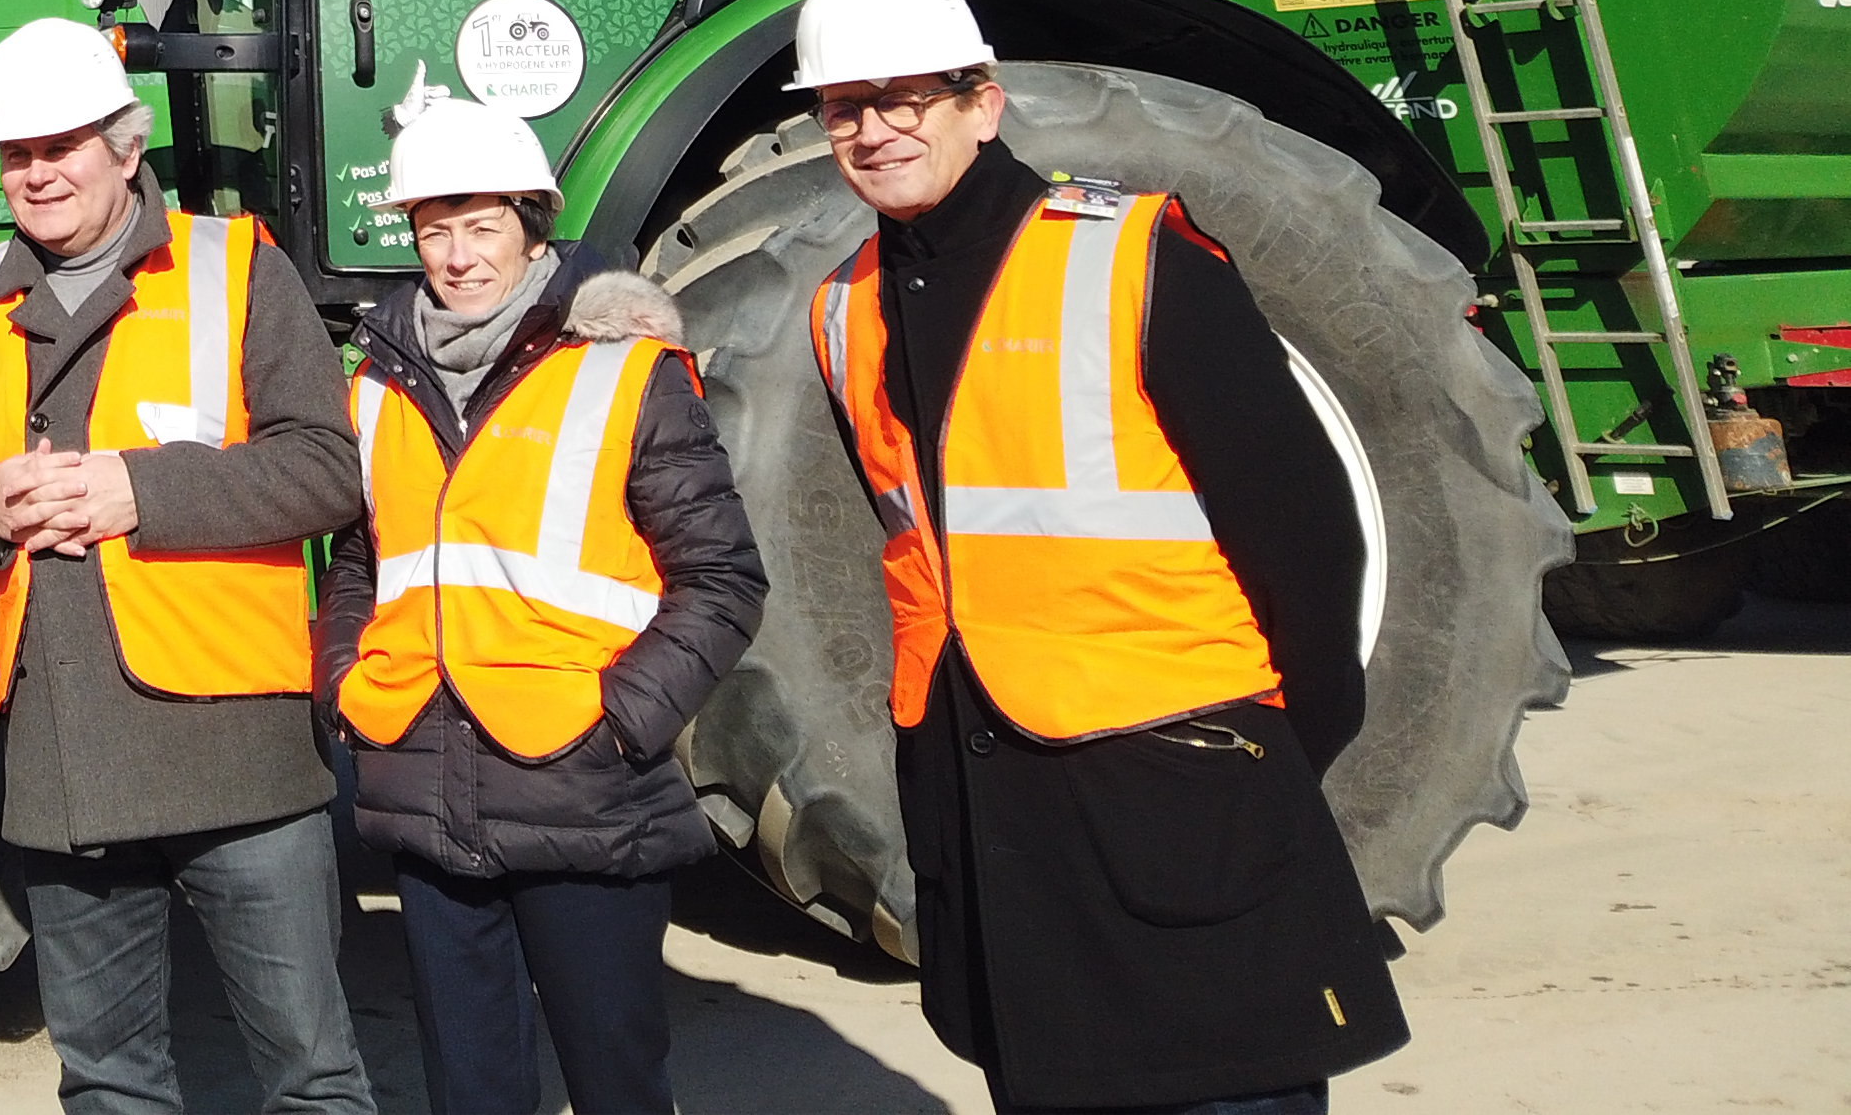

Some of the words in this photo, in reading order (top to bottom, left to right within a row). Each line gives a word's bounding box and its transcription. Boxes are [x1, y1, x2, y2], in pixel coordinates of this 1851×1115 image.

[1335, 11, 1440, 33] DANGER
[496, 45, 571, 57] TRACTEUR
[549, 60, 571, 69] VERT
[501, 83, 559, 96] CHARIER
[351, 166, 377, 181] Pas
[357, 191, 382, 206] Pas
[374, 213, 402, 227] 80%
[380, 233, 397, 247] de
